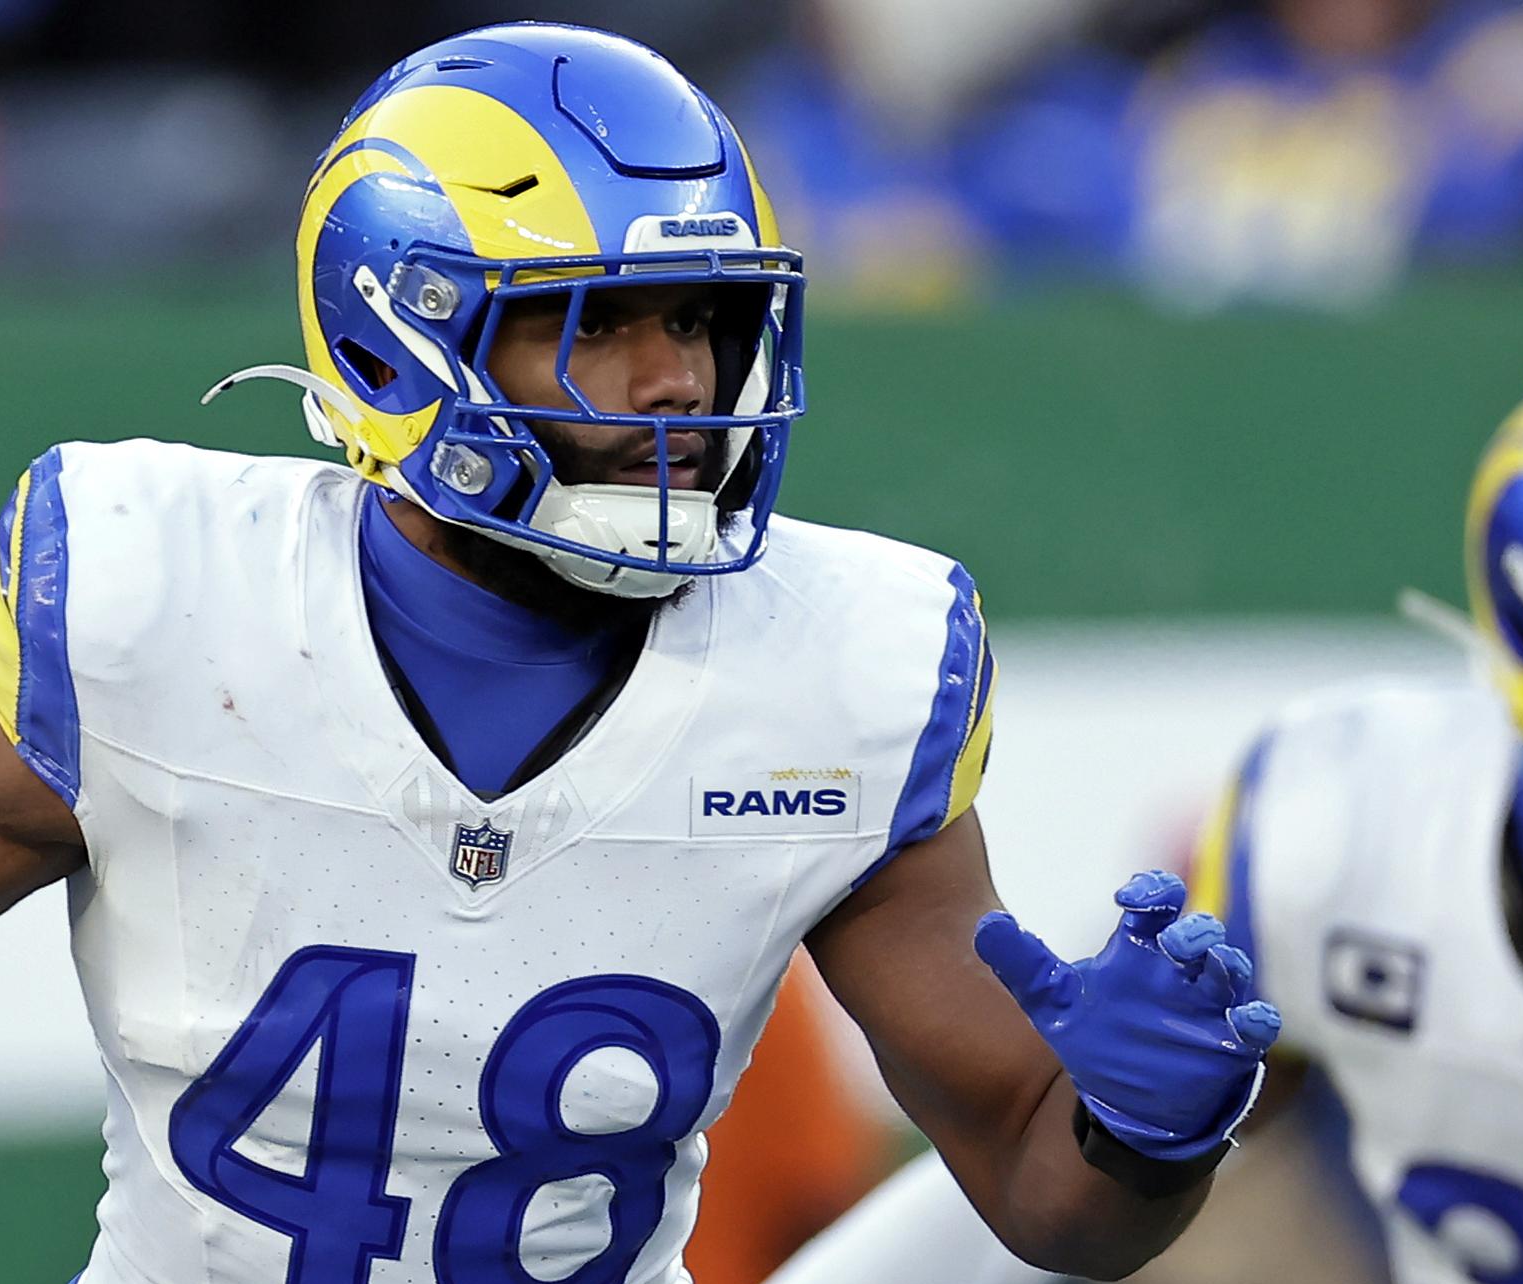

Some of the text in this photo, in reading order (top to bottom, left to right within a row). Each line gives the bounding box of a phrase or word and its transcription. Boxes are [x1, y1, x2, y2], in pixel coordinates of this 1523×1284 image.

[660, 218, 739, 237] RAMS
[703, 788, 848, 817] RAMS
[458, 846, 499, 878] NFL
